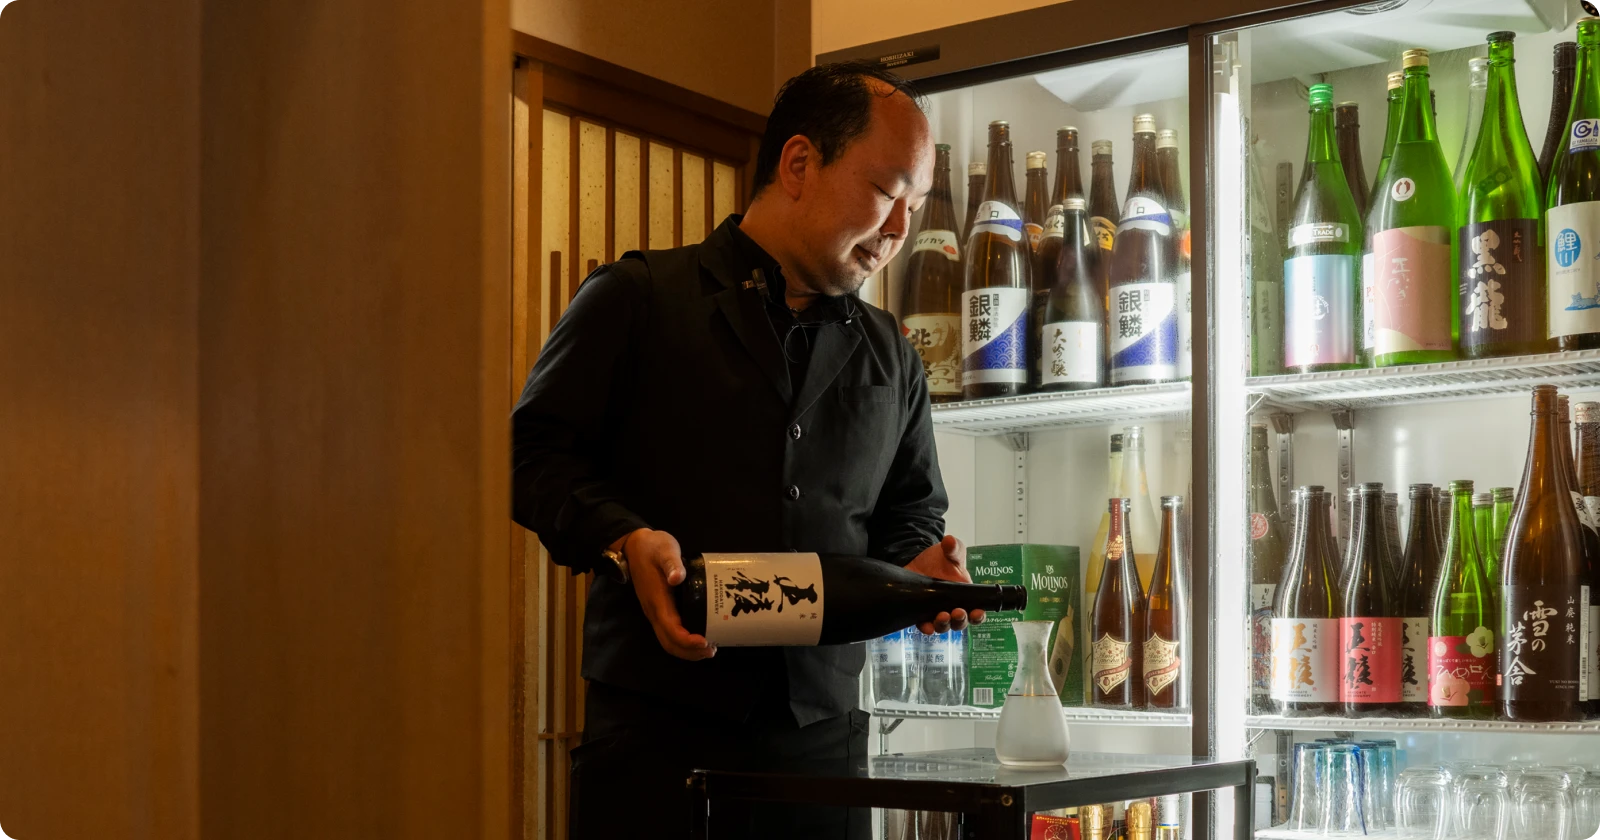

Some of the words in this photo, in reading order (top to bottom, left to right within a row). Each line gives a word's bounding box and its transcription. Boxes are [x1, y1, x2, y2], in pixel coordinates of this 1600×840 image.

[880, 51, 914, 62] HOSHIZAKI
[887, 59, 908, 67] INVERTER
[1557, 231, 1578, 266] 鯉川
[969, 294, 991, 342] 銀鱗
[1118, 290, 1142, 339] 銀鱗
[1051, 328, 1068, 376] 大吟醸
[975, 565, 1014, 577] MOLINOS
[1045, 564, 1055, 574] LOS
[1031, 573, 1068, 593] MOLINOS
[1523, 600, 1558, 651] 雪の
